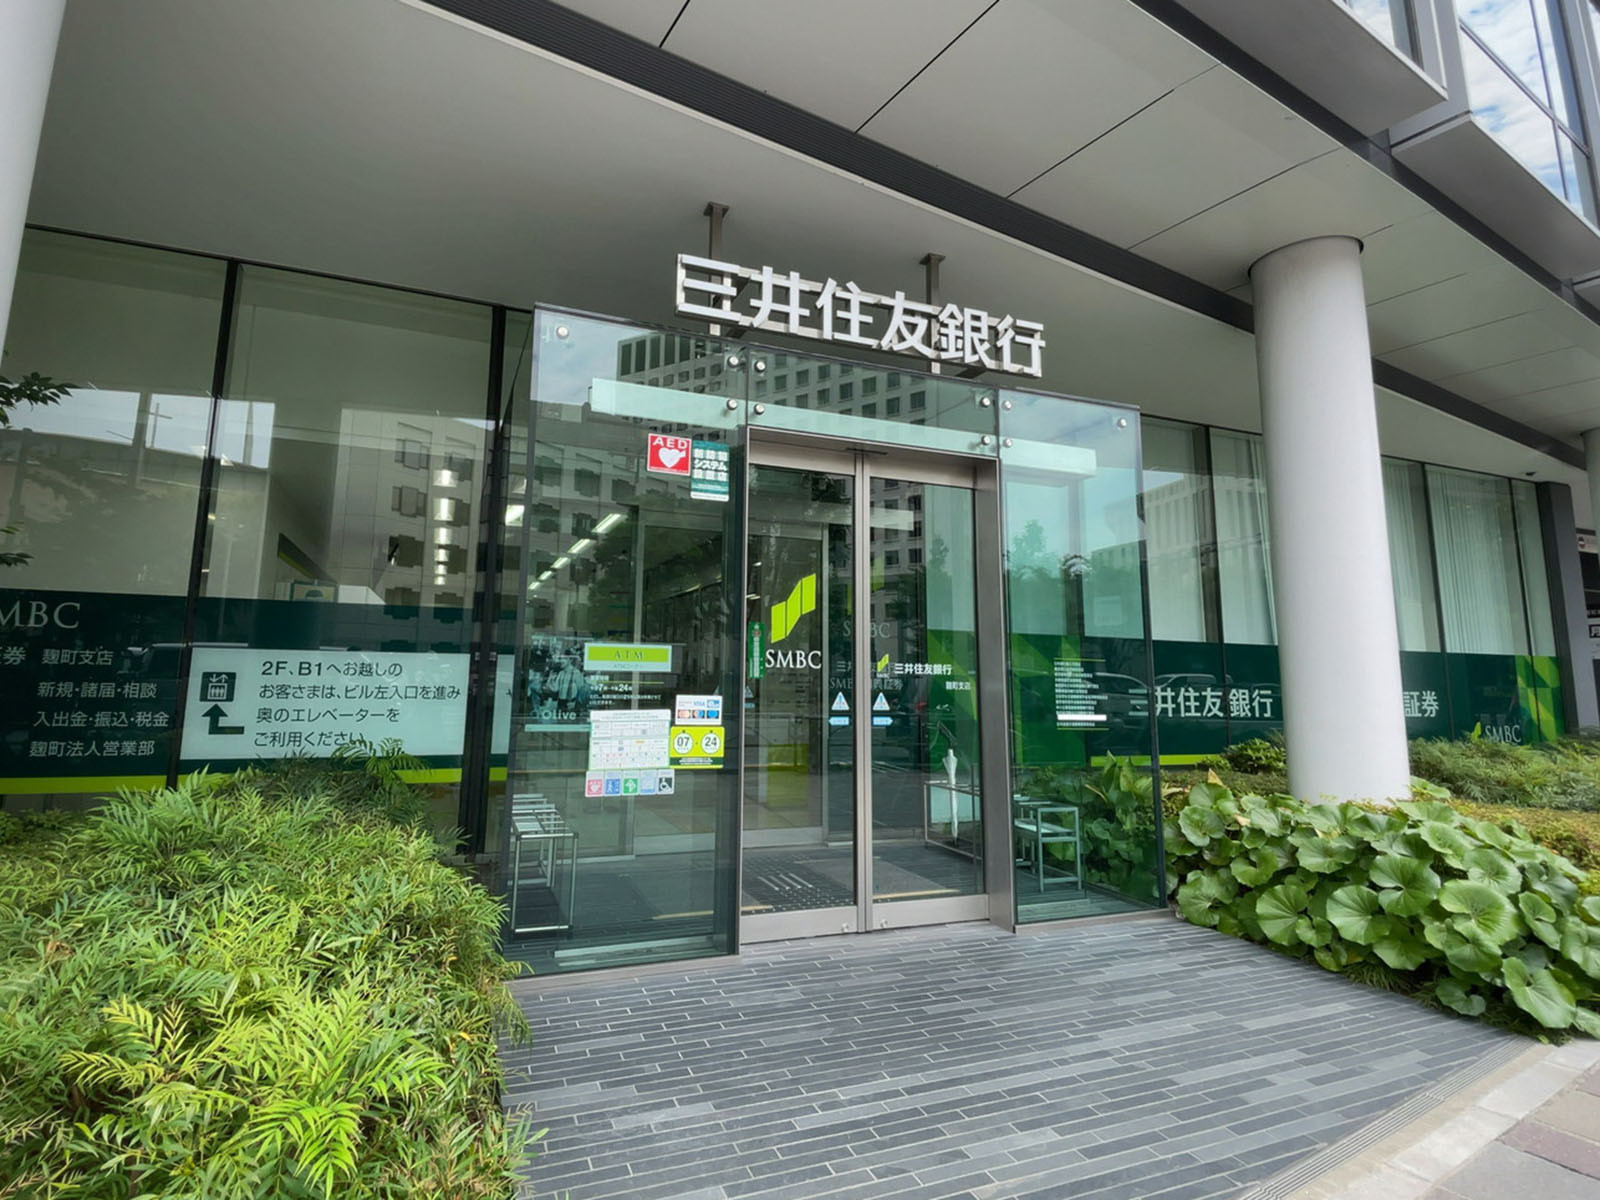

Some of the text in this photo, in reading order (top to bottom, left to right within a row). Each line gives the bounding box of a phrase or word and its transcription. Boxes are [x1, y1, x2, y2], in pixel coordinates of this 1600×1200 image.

[677, 253, 1046, 378] 三井住友銀行
[652, 436, 688, 449] AED
[693, 459, 728, 471] システム
[0, 645, 26, 665] 券
[614, 649, 645, 660] ATM
[765, 648, 822, 669] SMBC
[893, 662, 953, 676] 三井住友銀行
[258, 683, 461, 700] お客さまは、ビル左入口を進み
[1128, 686, 1274, 718] 三井住友銀行
[256, 708, 401, 724] 奥のエレベーターを
[541, 709, 577, 720] Olive
[676, 736, 717, 747] 07 24
